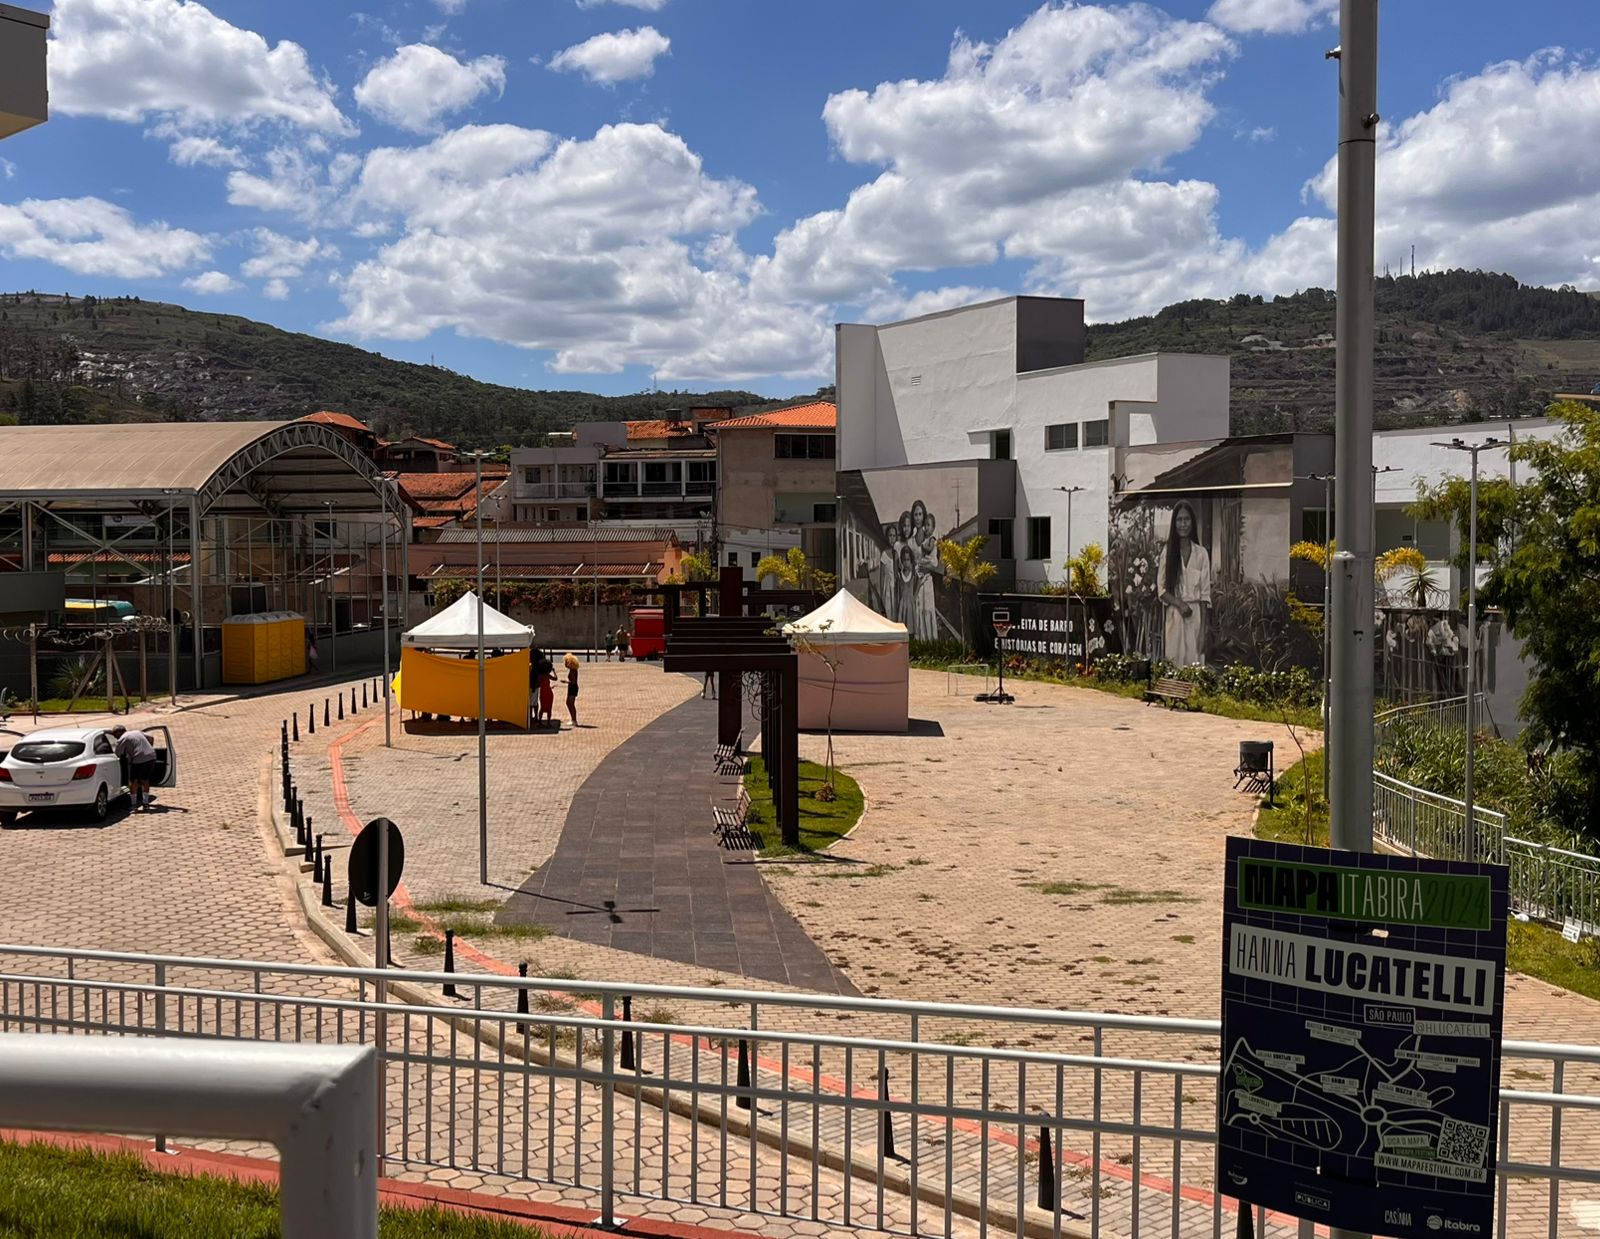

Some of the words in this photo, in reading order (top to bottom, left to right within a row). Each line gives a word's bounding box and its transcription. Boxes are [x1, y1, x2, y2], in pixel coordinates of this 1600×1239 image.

[1038, 619, 1049, 631] DE
[1037, 640, 1047, 654] DE
[1244, 863, 1339, 913] MAPA
[1340, 872, 1425, 921] ITABIRA
[1424, 879, 1487, 925] 2024
[1236, 932, 1296, 980] HANNA
[1305, 944, 1487, 1007] LUCATELLI
[1368, 1007, 1385, 1022] SÃO
[1386, 1009, 1412, 1024] PAULO
[1415, 1022, 1488, 1036] @HLUCATELLI
[1378, 1154, 1483, 1180] WWW.MAPAFESTIVAL.COM.BR
[1444, 1219, 1481, 1233] Itabira
